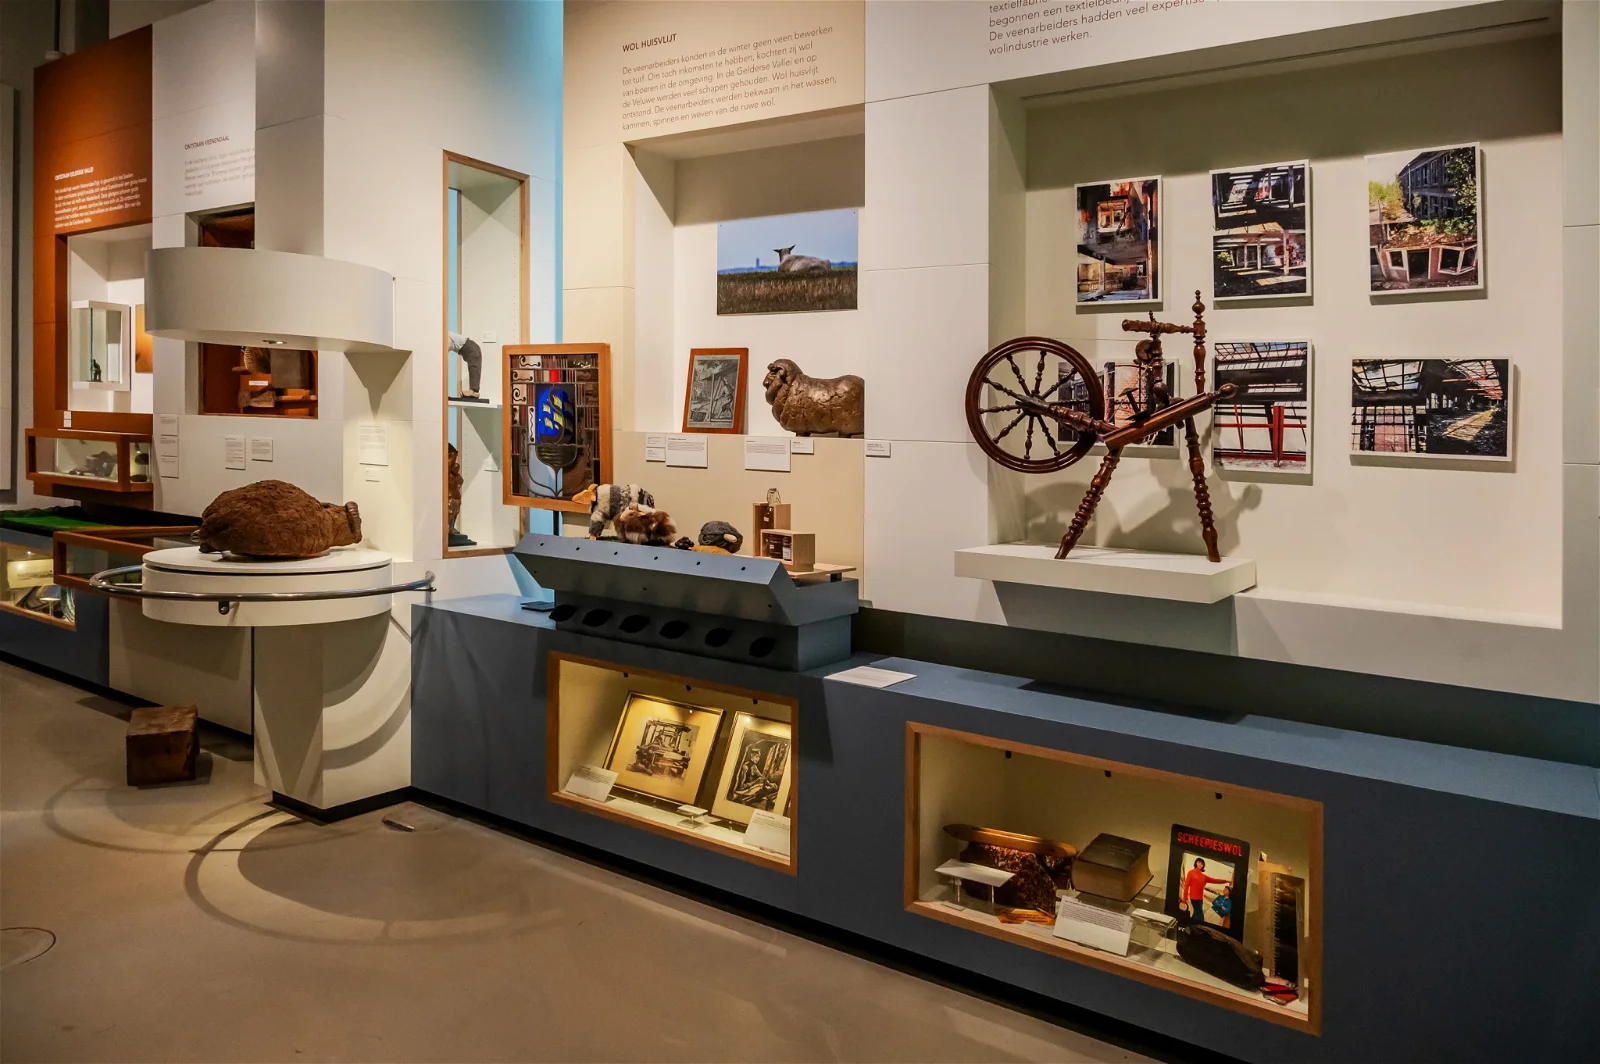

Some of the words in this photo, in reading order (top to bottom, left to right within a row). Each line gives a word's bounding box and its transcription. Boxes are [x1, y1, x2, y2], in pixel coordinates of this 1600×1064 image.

[989, 31, 1003, 41] De
[1006, 18, 1078, 38] veenarbeiders
[1082, 10, 1122, 24] hadden
[1126, 3, 1148, 16] veel
[1152, 0, 1204, 11] expert
[990, 0, 1048, 13] textielfab
[990, 11, 1040, 27] begonnen
[1043, 7, 1062, 17] een
[1065, 0, 1129, 12] textielbe
[622, 42, 639, 52] WOL
[641, 34, 677, 48] HUISVLIJT
[633, 58, 679, 72] veenarbeiders
[681, 52, 707, 62] konden
[718, 47, 726, 55] de
[729, 44, 750, 52] winter
[753, 39, 771, 50] geen
[774, 34, 792, 44] veen
[794, 26, 833, 39] bewerken
[662, 69, 677, 78] toch
[679, 63, 713, 75] inkomsten
[757, 48, 786, 60] kochten
[799, 40, 813, 51] wol
[989, 38, 1048, 55] wolindustrie
[1052, 30, 1092, 44] werken.
[622, 89, 633, 97] van
[635, 85, 658, 94] boeren
[668, 80, 677, 88] de
[726, 69, 734, 78] de
[737, 63, 770, 76] Gelderse
[807, 54, 817, 63] op
[622, 100, 630, 108] de
[657, 92, 681, 101] werden
[683, 88, 697, 97] veel
[699, 83, 728, 94] schapen
[772, 71, 787, 80] Wol
[666, 99, 714, 112] veenarbeiders
[716, 93, 742, 103] werden
[745, 86, 779, 98] bekwaam
[791, 82, 804, 90] het
[806, 76, 836, 87] wassen,
[691, 109, 713, 119] weven
[740, 102, 758, 111] ruwe
